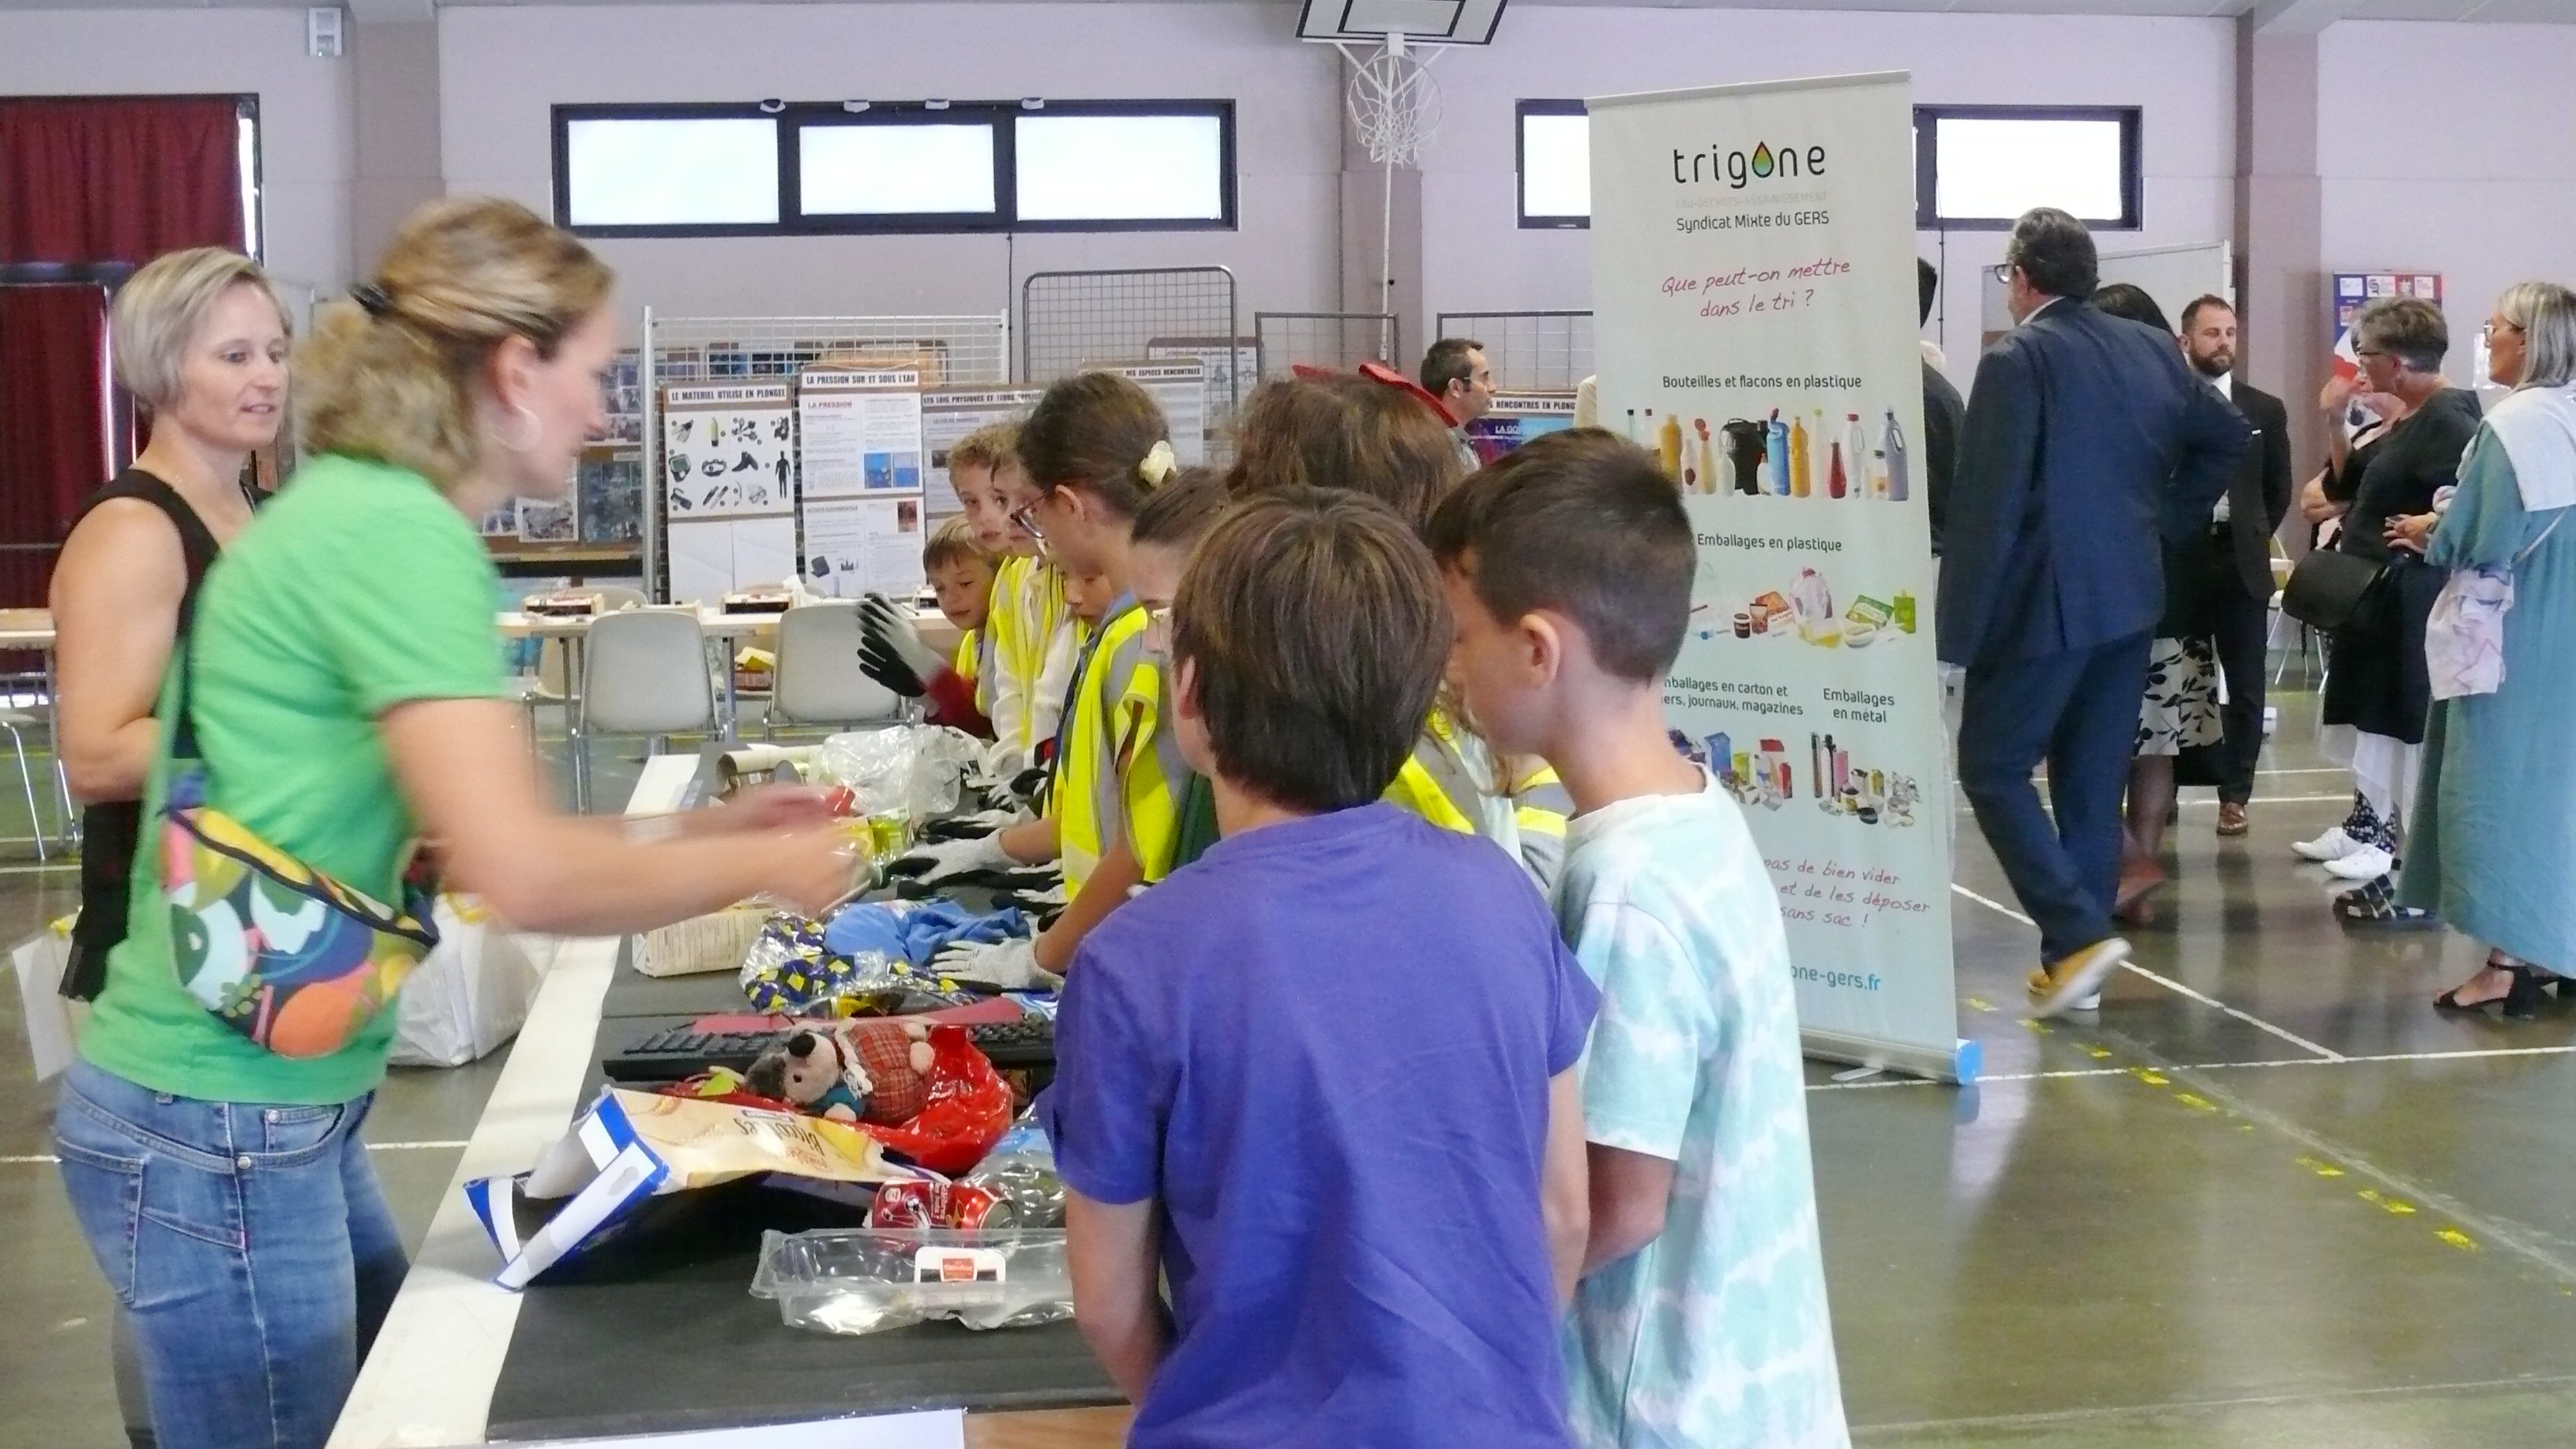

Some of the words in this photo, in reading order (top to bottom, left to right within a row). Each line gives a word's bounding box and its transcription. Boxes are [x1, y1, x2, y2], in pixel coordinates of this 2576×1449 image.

[1673, 141, 1825, 189] trigone
[1677, 215, 1731, 234] Syndicat
[1735, 213, 1771, 229] Mixte
[1775, 212, 1790, 226] du
[1794, 211, 1829, 225] GERS
[1662, 275, 1697, 298] Que
[1701, 267, 1780, 296] peut-on
[1788, 257, 1851, 277] mettre
[1700, 300, 1740, 318] dans
[1749, 293, 1765, 313] le
[1772, 290, 1795, 310] tri
[1805, 289, 1814, 307] ?
[816, 375, 849, 384] PRESSION
[869, 374, 875, 383] ET
[879, 374, 896, 383] SOUS
[1662, 375, 1721, 388] Bouteilles
[1724, 377, 1736, 387] et
[1739, 374, 1782, 388] flacons
[1786, 378, 1800, 388] en
[1803, 375, 1862, 391] plastique
[672, 392, 678, 401] LE
[682, 391, 714, 400] MATERIEL
[718, 390, 742, 400] UTILISE
[757, 388, 786, 397] PLONGEE
[1697, 533, 1765, 552] Emballages
[1769, 538, 1783, 548] en
[1787, 535, 1842, 552] plastique
[1665, 676, 1718, 693] mballages
[1721, 682, 1734, 692] en
[1738, 684, 1773, 696] carton
[1776, 685, 1788, 696] et
[1688, 694, 1739, 711] journaux,
[1742, 701, 1803, 716] magazines
[1823, 688, 1895, 707] Emballages
[1833, 707, 1848, 719] en
[1852, 707, 1887, 723] métal
[1797, 859, 1815, 874] de
[1823, 860, 1855, 880] bien
[1862, 866, 1900, 885] vider
[1780, 881, 1797, 896] et
[1805, 883, 1822, 898] de
[1829, 886, 1854, 903] les
[1862, 892, 1931, 913] déposer
[1780, 905, 1815, 921] sans
[1823, 914, 1852, 926] sac
[1862, 914, 1869, 927] !
